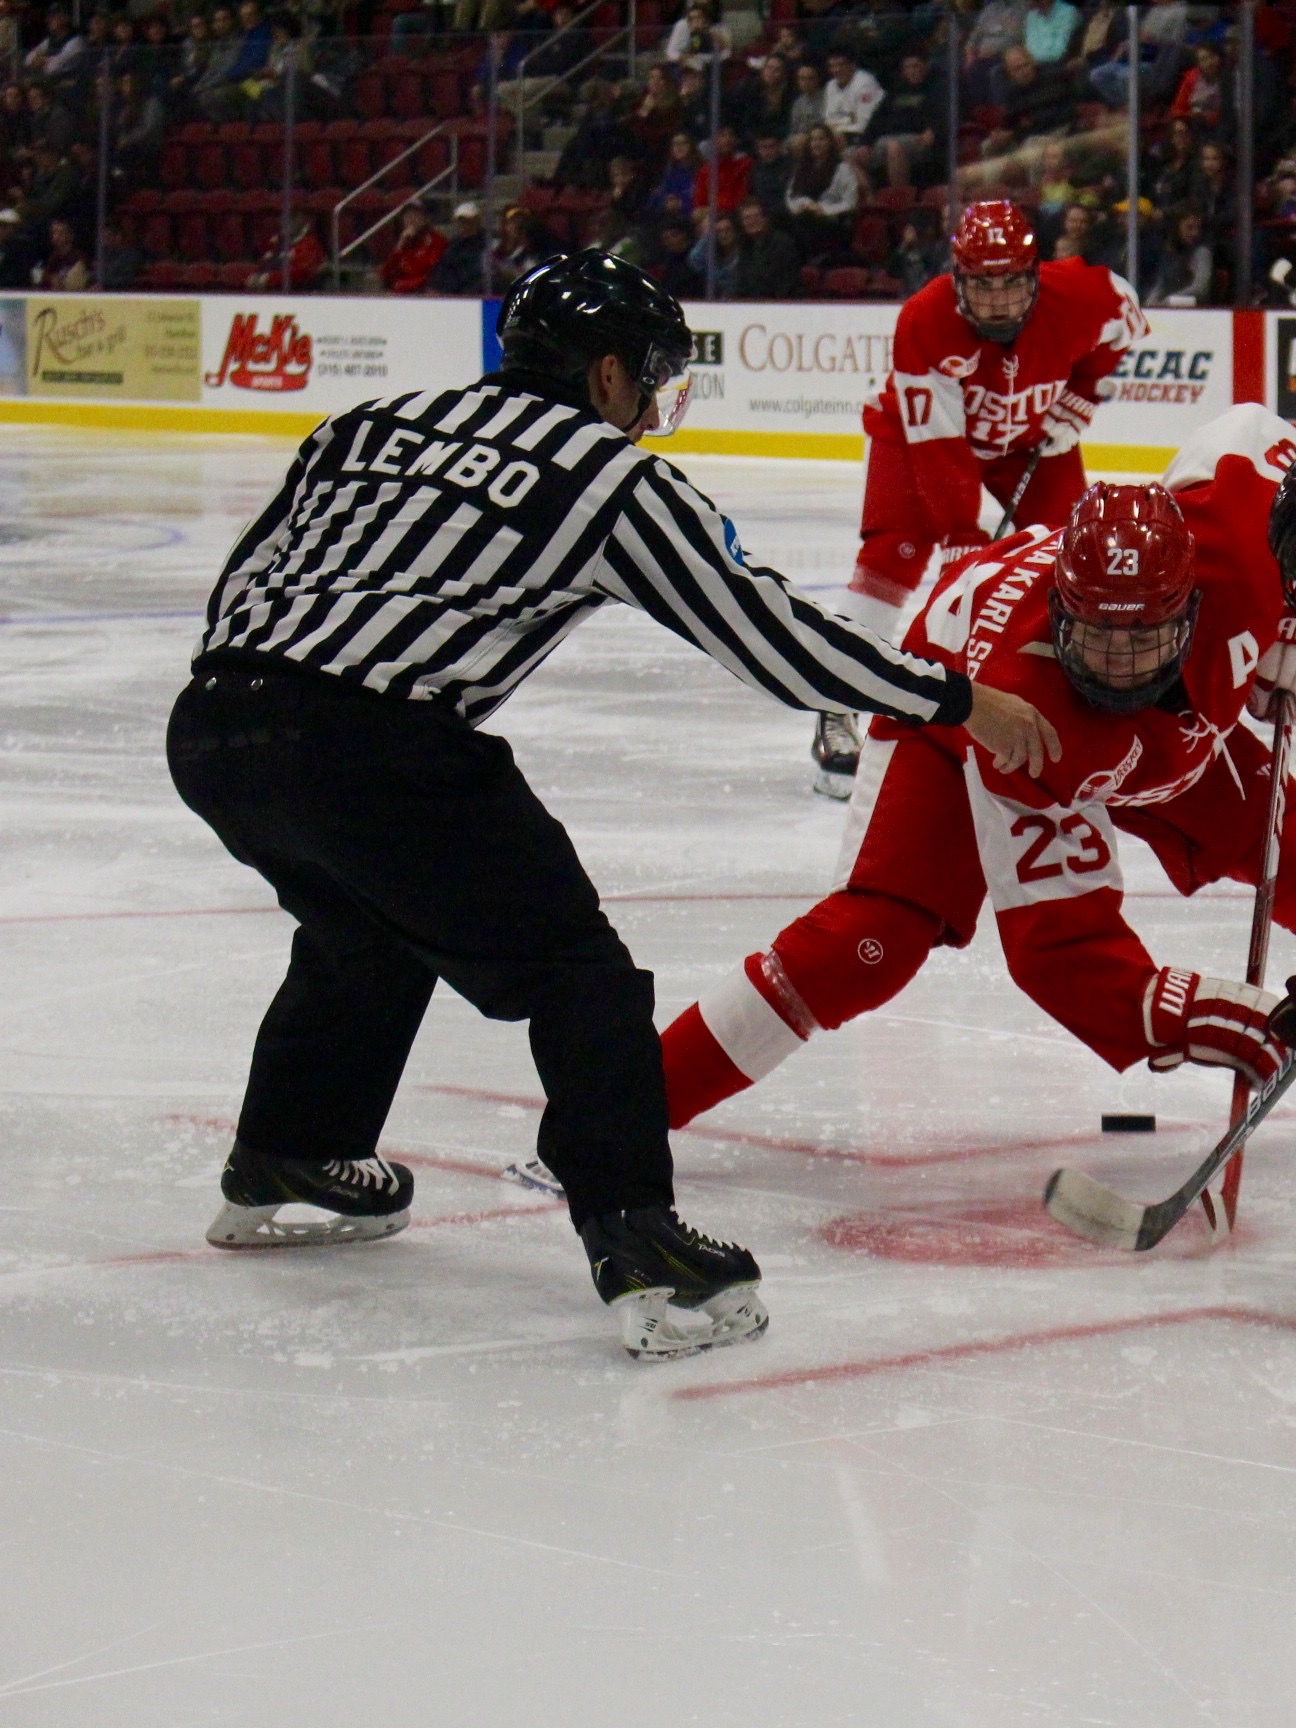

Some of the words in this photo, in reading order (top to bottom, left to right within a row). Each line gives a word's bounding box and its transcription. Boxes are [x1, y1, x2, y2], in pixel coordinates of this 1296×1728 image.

[1111, 349, 1213, 380] ECAC
[904, 386, 933, 426] 17
[1119, 382, 1206, 403] HOCKEY
[972, 421, 1030, 446] 17
[341, 419, 541, 509] LEMBO
[1106, 548, 1139, 576] 23
[1099, 602, 1146, 612] BAUER
[1227, 630, 1259, 690] A
[1010, 812, 1111, 884] 23
